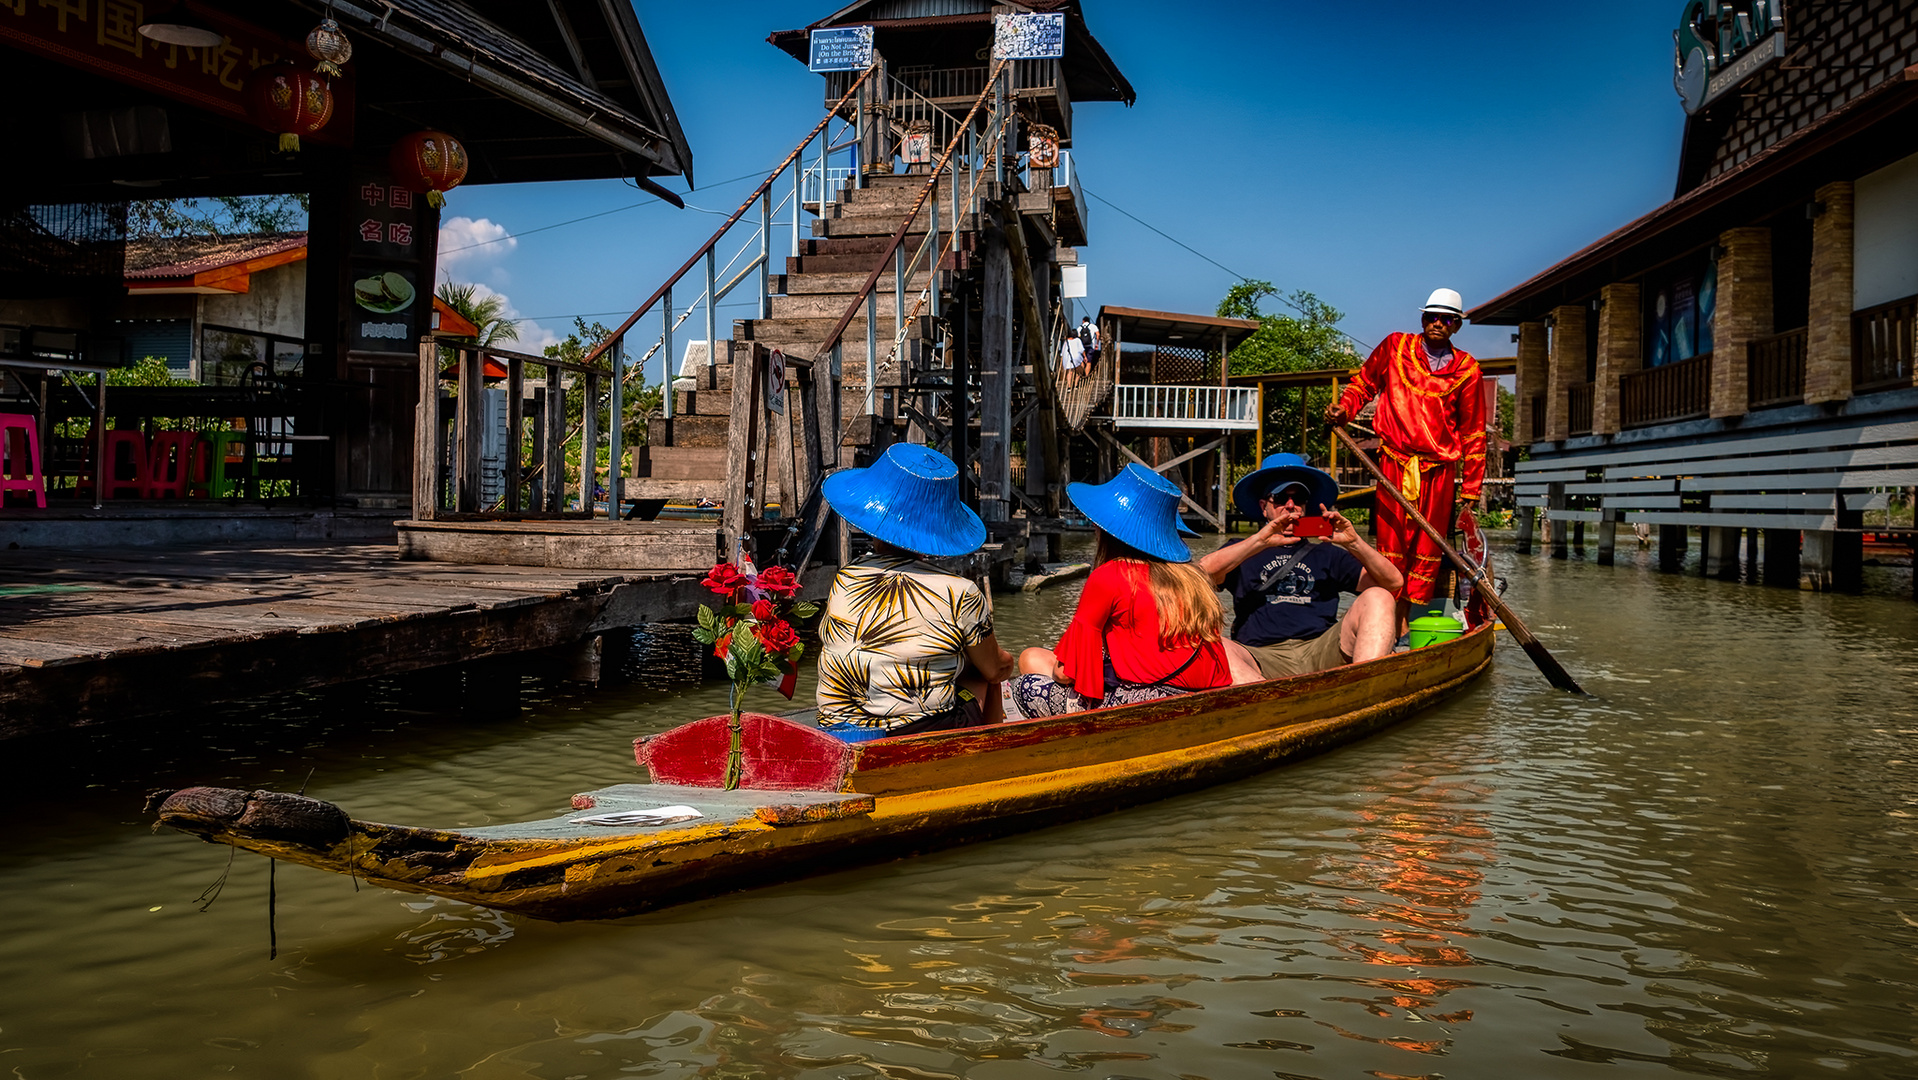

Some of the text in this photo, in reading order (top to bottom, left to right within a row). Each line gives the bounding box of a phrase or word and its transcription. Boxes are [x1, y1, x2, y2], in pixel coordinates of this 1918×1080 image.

[0, 0, 280, 92] 中国小吃
[361, 182, 413, 210] 中国
[359, 218, 413, 246] 名吃
[1263, 559, 1312, 574] ERVEIRO
